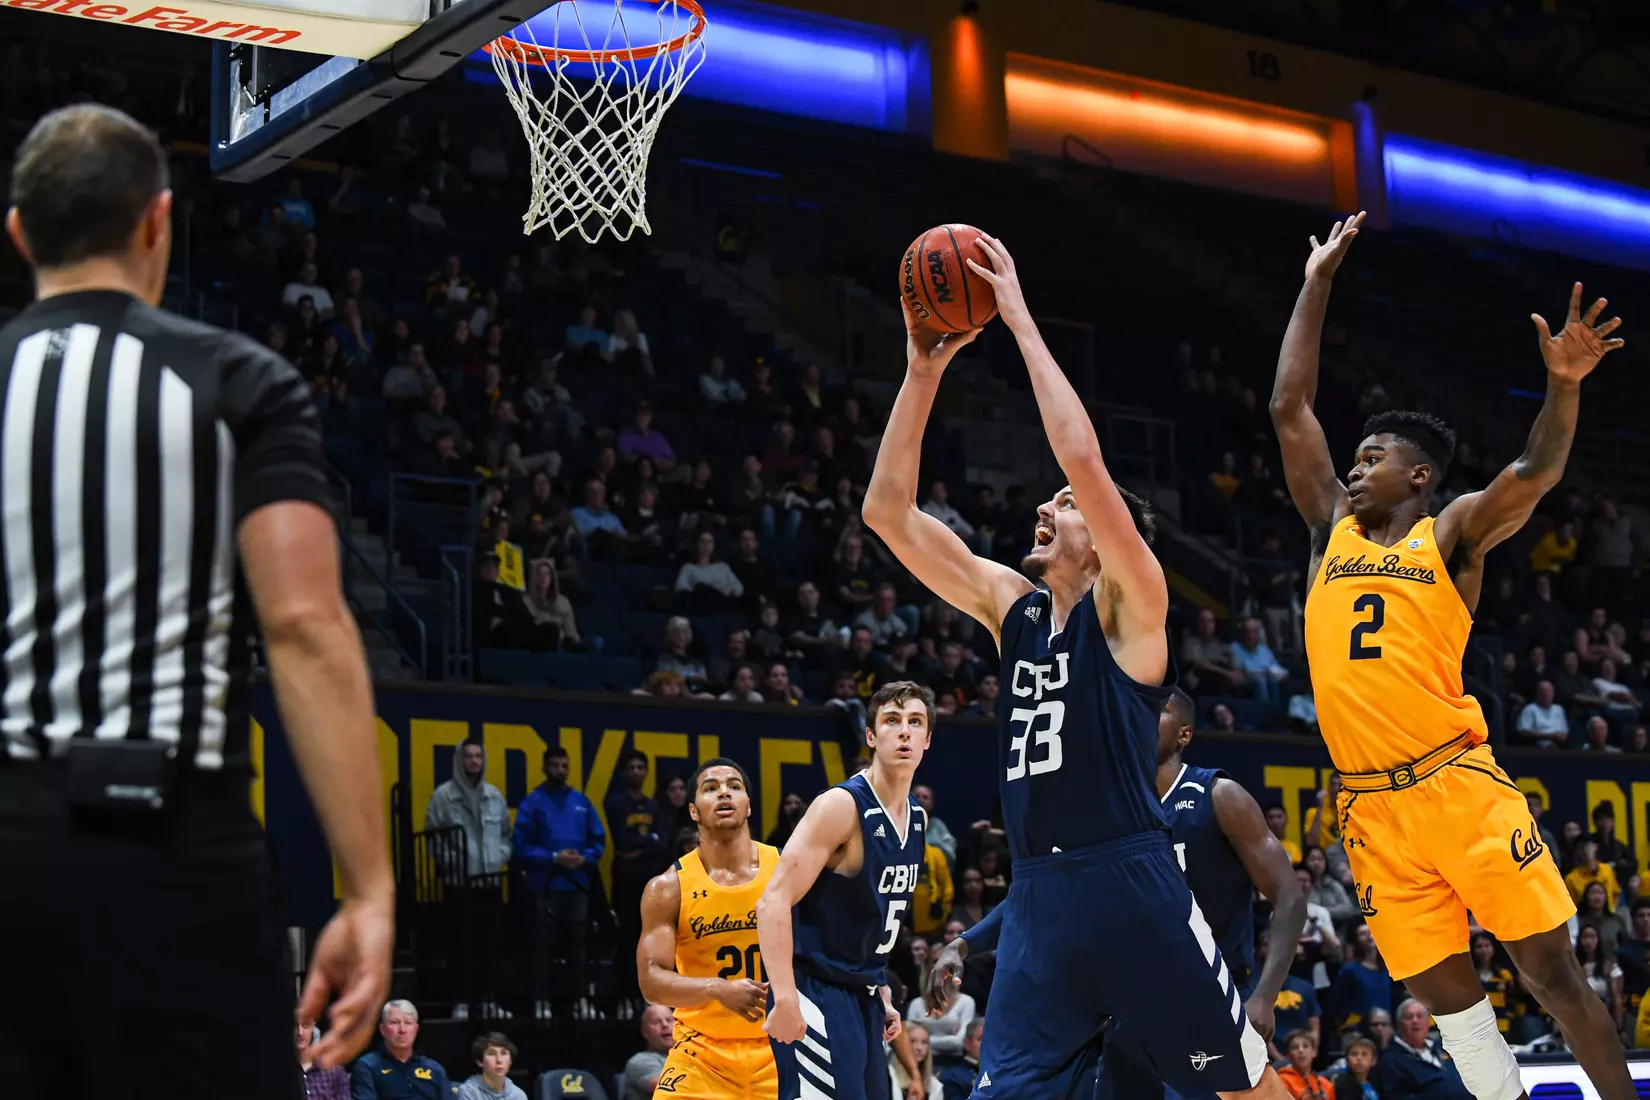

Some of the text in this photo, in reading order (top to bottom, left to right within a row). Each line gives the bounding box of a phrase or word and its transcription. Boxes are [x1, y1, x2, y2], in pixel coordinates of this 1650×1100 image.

[0, 0, 302, 45] ate Farm
[927, 249, 955, 303] NCAA
[1324, 554, 1437, 585] Golden Bears
[1349, 593, 1385, 660] 2
[1006, 700, 1066, 782] 33
[1175, 800, 1195, 811] WAC
[914, 823, 922, 831] WA
[1511, 821, 1543, 871] Cal
[878, 863, 919, 894] CBU
[689, 914, 742, 940] Golden
[875, 900, 908, 955] 5
[414, 1067, 432, 1080] Cal
[561, 1073, 584, 1093] Cal
